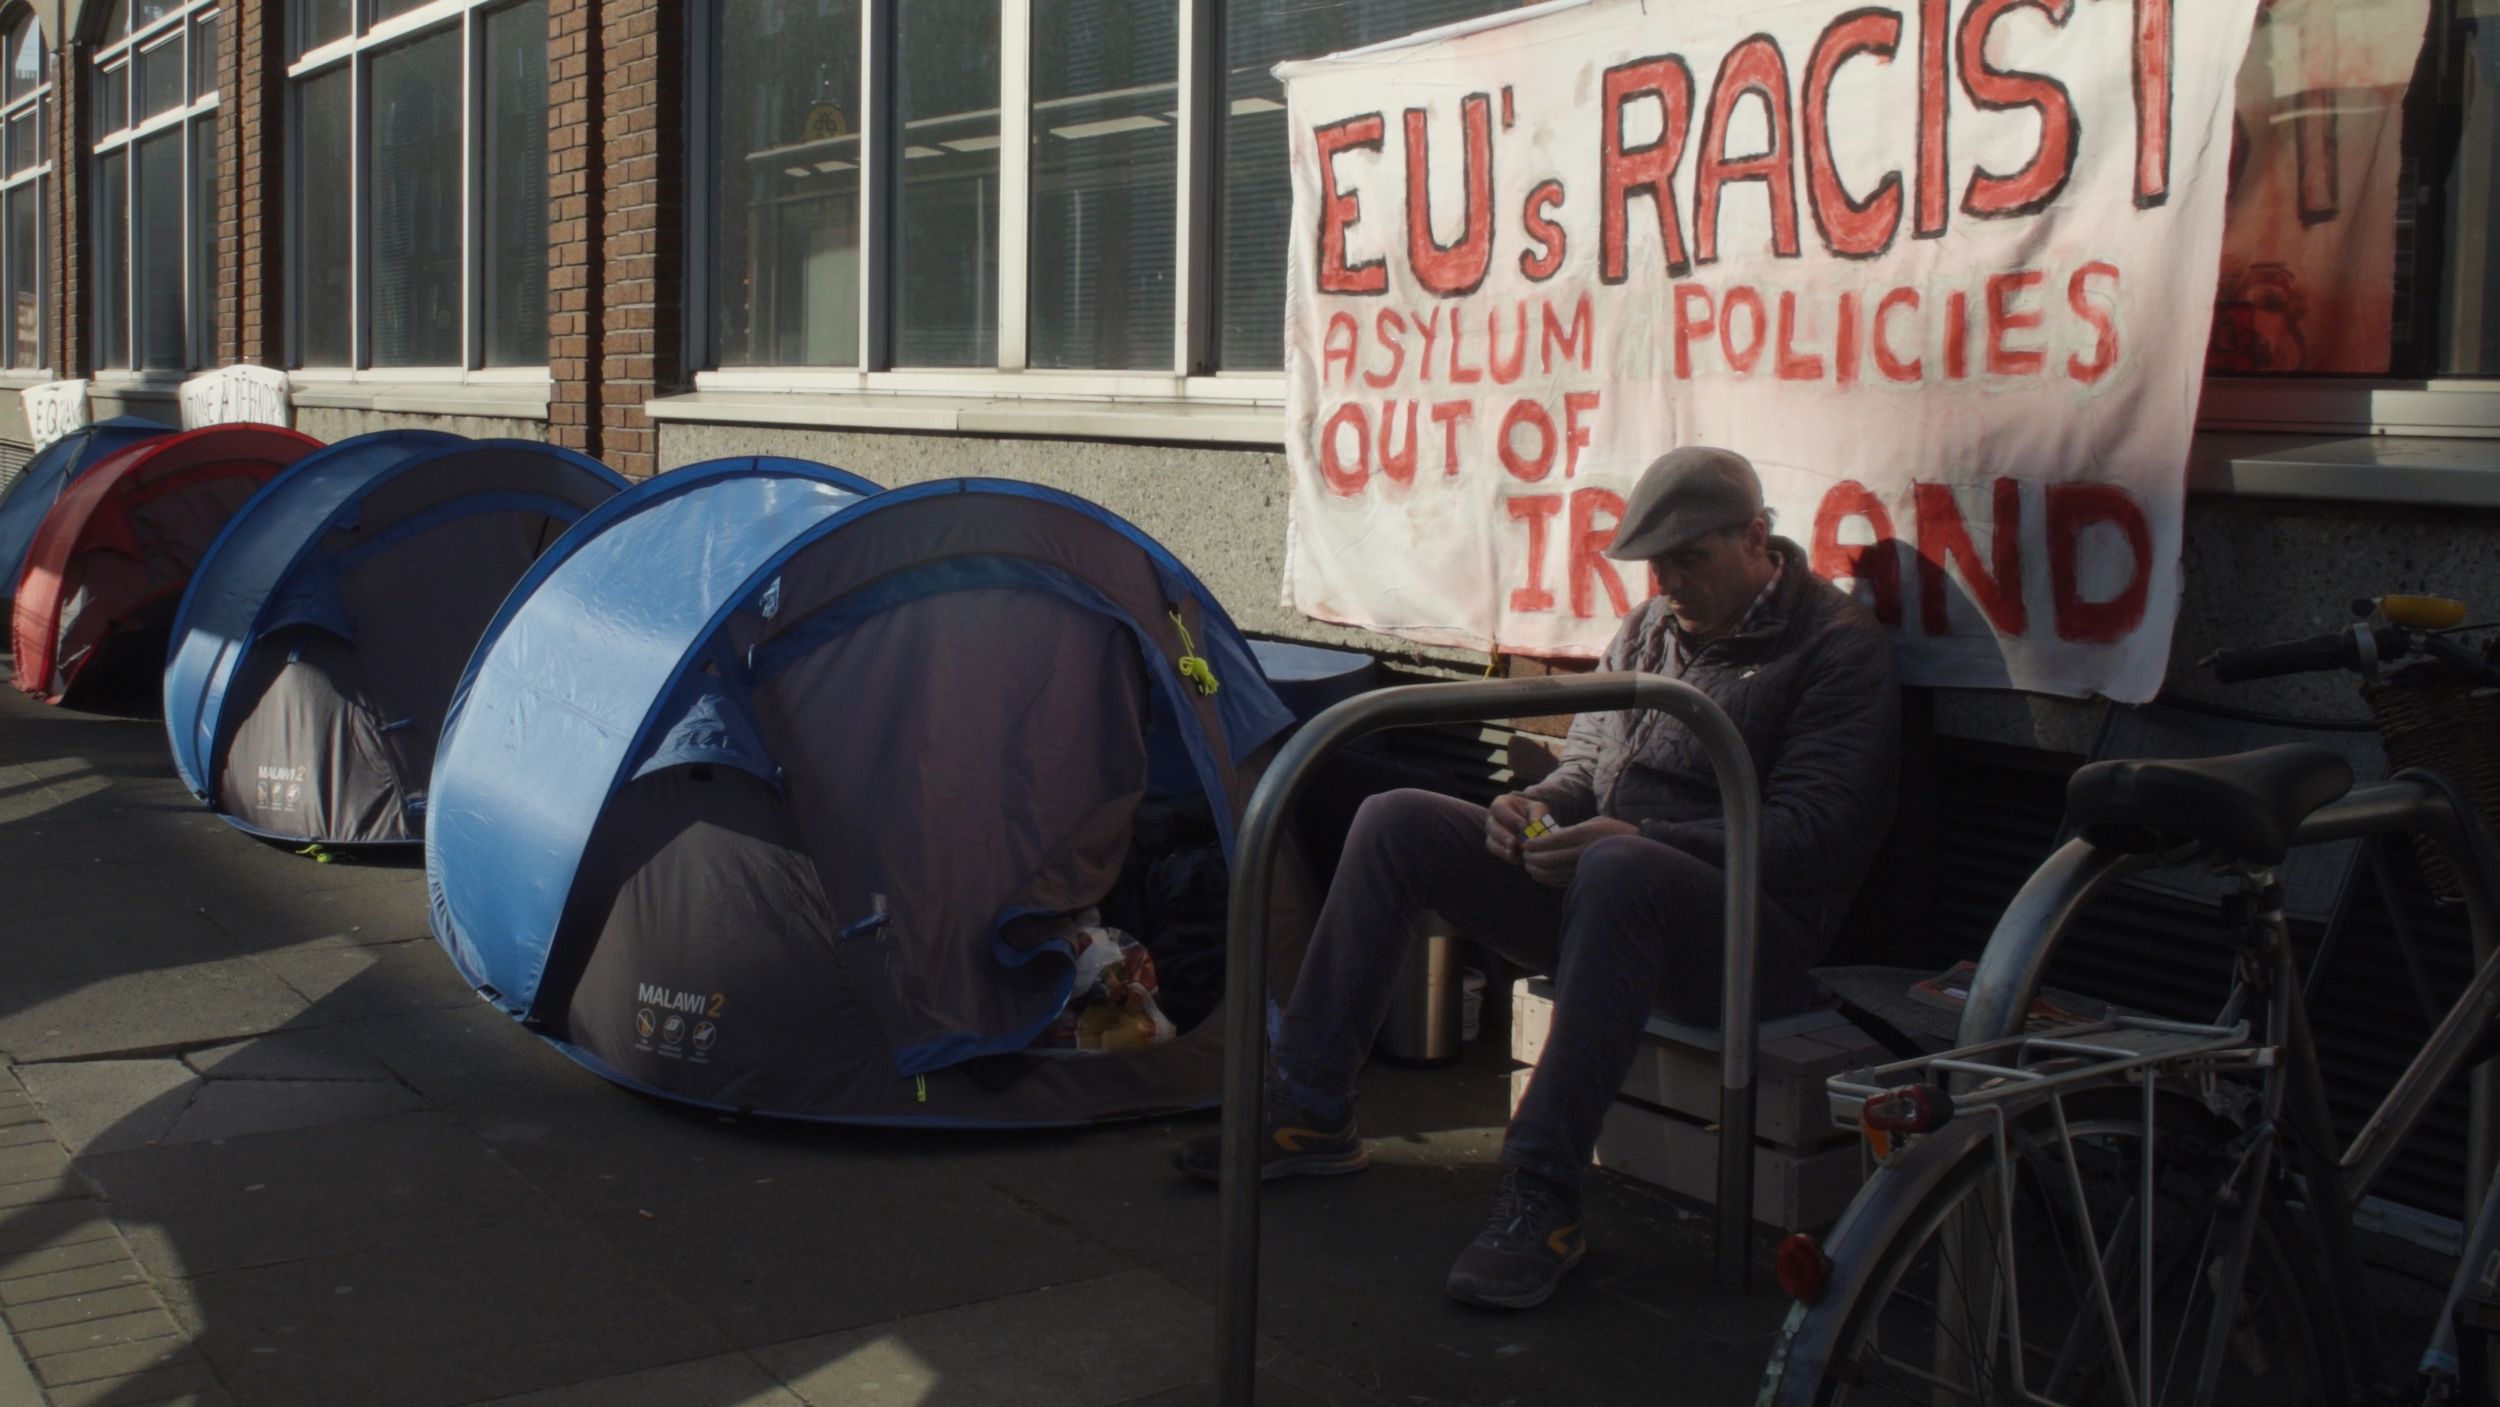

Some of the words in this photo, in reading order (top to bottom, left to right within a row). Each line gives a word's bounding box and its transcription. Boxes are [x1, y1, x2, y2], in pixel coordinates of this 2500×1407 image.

[1323, 290, 1595, 389] ASYLUM
[1674, 260, 2120, 387] POLICIES
[1320, 399, 1473, 497] OUT
[1497, 391, 1600, 482] OF
[1507, 476, 2152, 644] IRAND
[637, 982, 706, 1014] MALAWI
[707, 992, 725, 1018] 2
